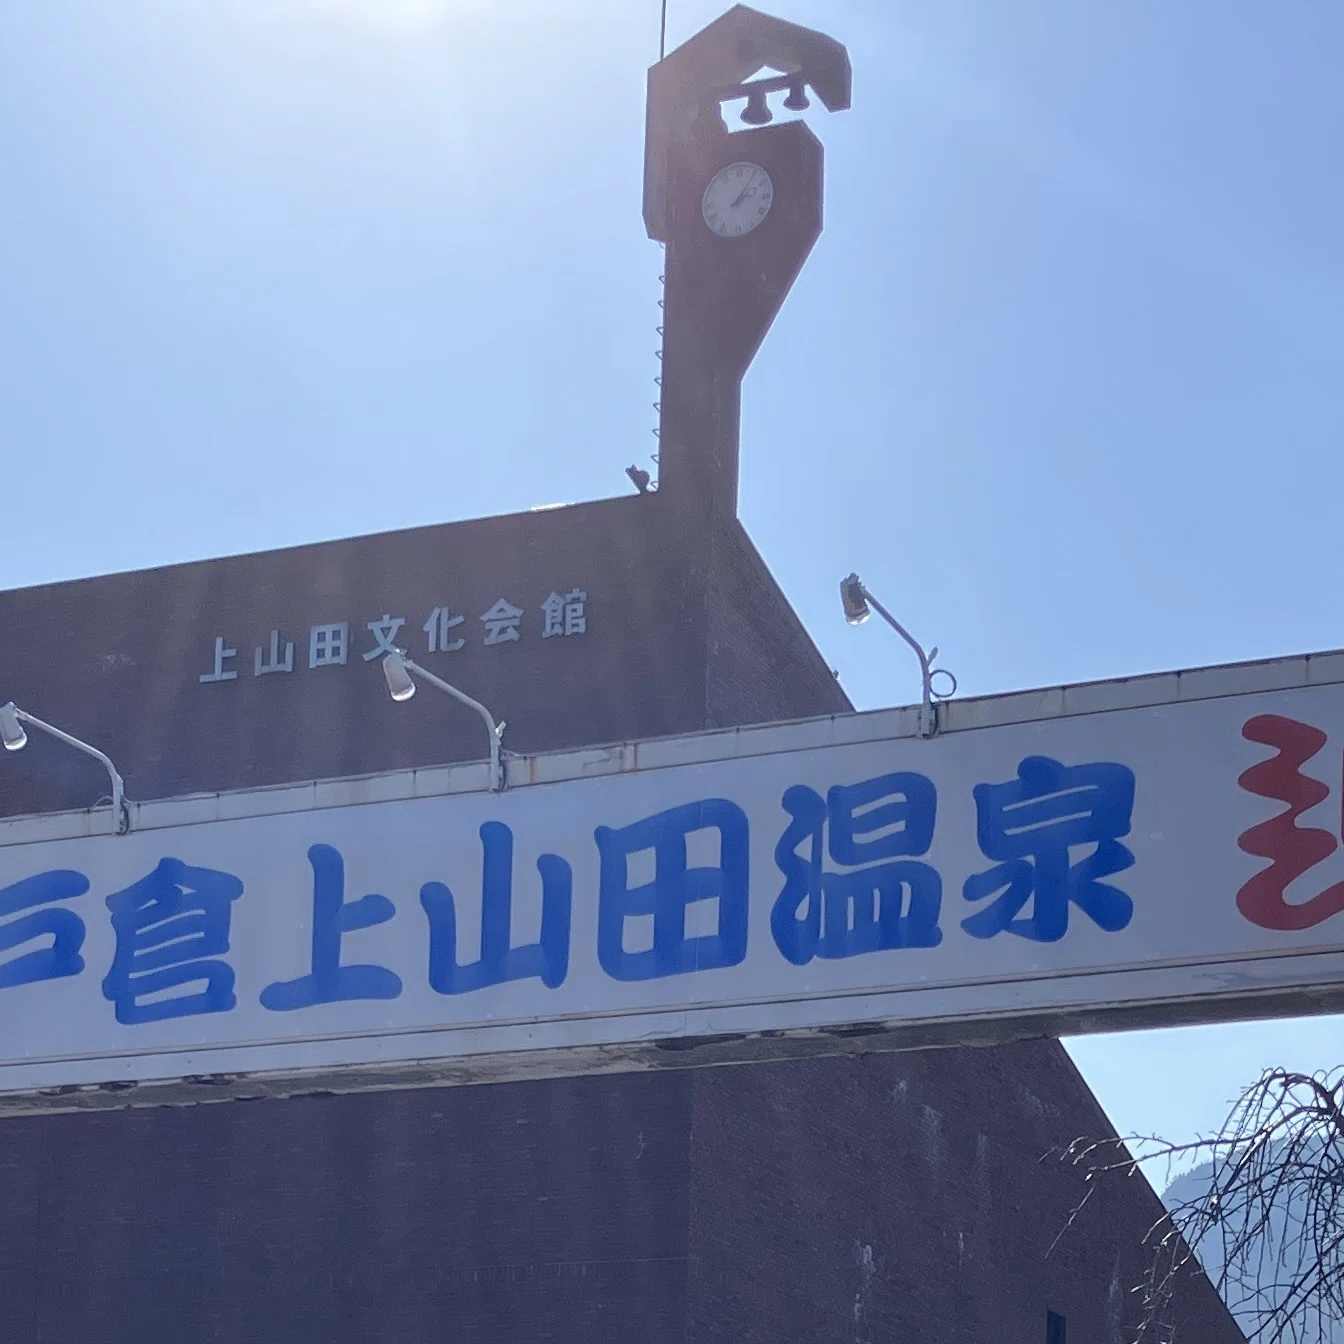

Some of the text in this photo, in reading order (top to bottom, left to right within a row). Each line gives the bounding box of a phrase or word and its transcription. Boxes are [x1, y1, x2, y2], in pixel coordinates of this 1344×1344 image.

[199, 588, 589, 683] 上山田文化会館
